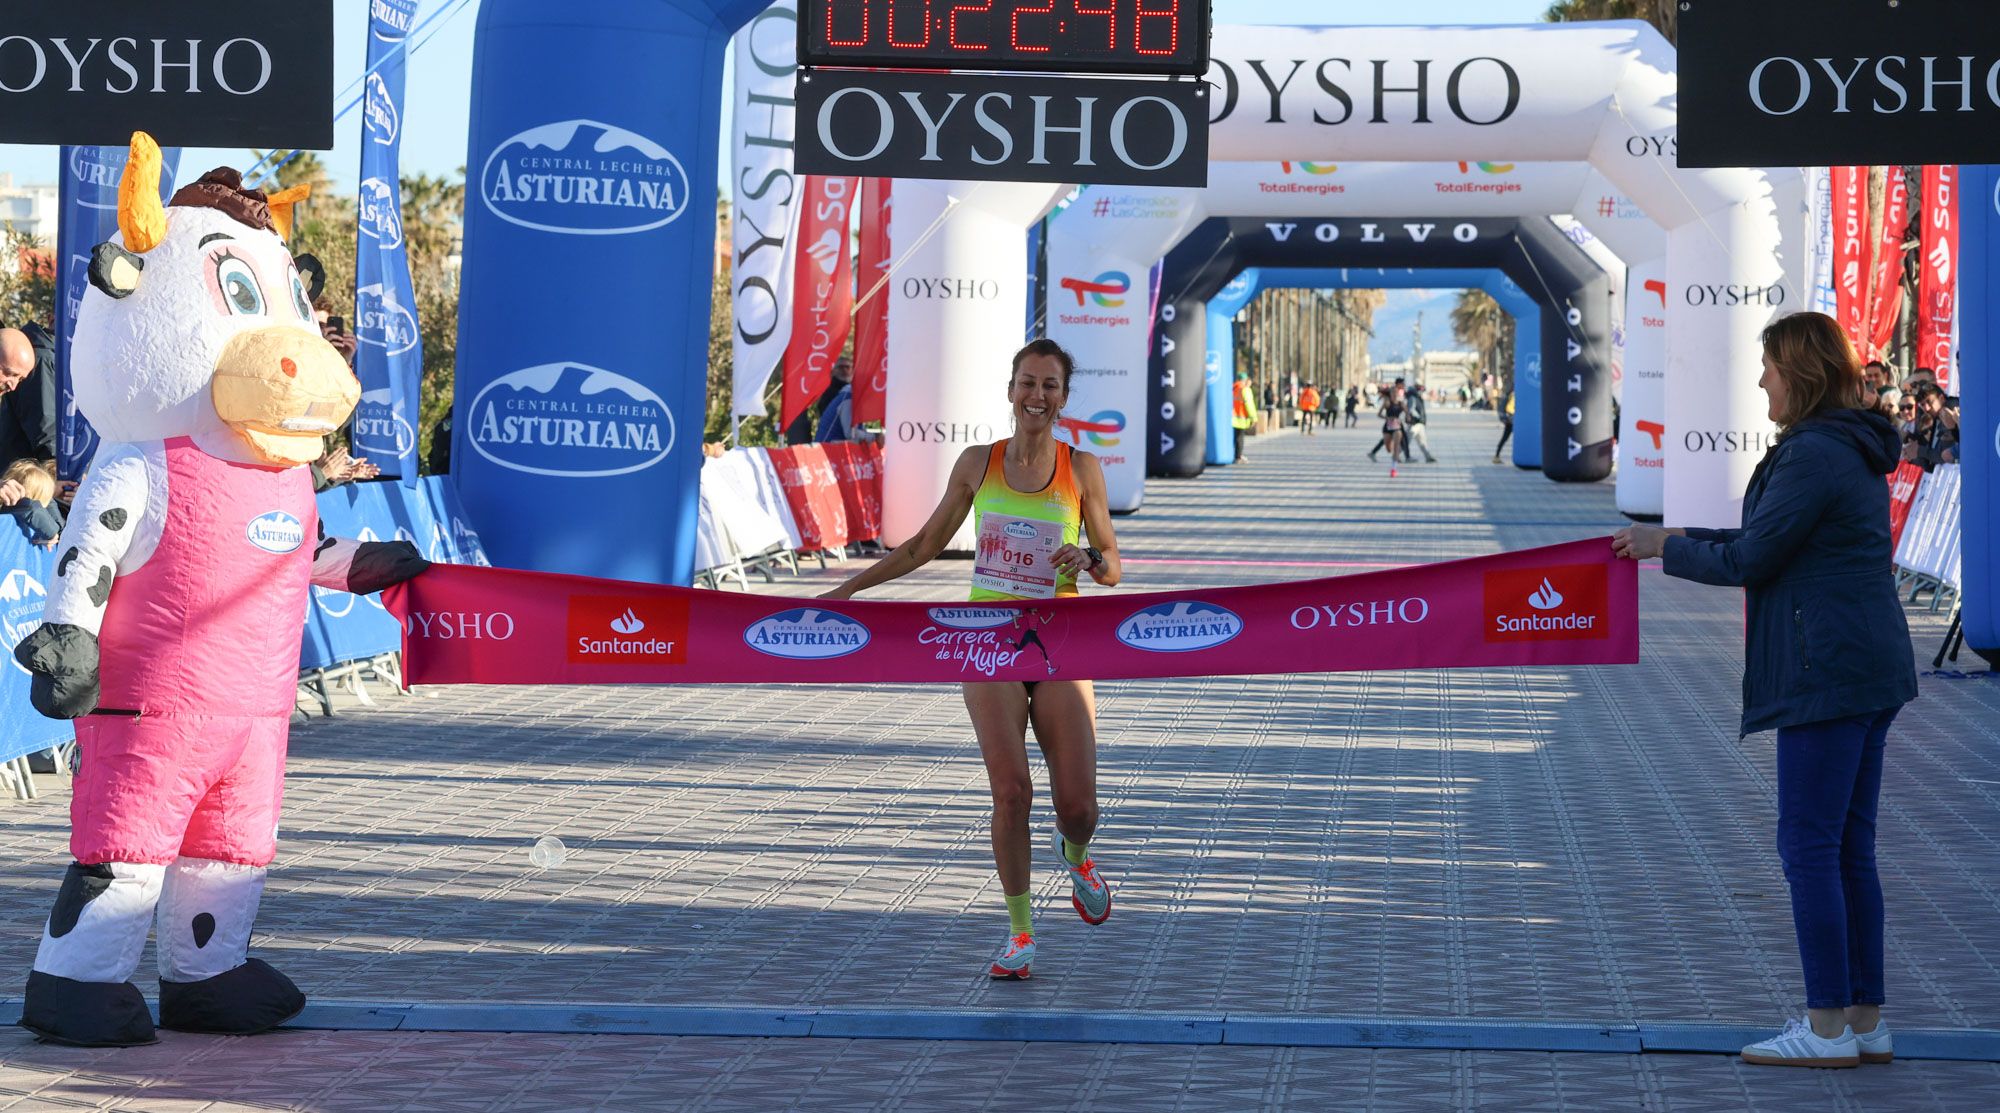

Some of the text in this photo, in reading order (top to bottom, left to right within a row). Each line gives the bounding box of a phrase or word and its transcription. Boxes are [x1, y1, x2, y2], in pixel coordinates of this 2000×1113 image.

[0, 36, 272, 95] OYSHO
[1749, 56, 2000, 115] OYSH
[817, 87, 1188, 170] OYSHO
[520, 157, 672, 177] CENTRAL LECHERA
[491, 159, 677, 212] ASTURIANA
[1259, 182, 1345, 195] TotalEnergies
[1435, 182, 1522, 194] TotalEnergies
[1265, 222, 1479, 242] VOLVO
[904, 278, 998, 300] OYSHO
[1685, 284, 1785, 307] OYSHO
[1060, 315, 1130, 327] TotalEnergies
[1642, 317, 1664, 328] Tota
[1160, 304, 1176, 456] VOLVO
[1567, 307, 1582, 459] VOLVO
[1638, 370, 1664, 379] totale
[506, 400, 658, 418] CENTRAL LECHERA
[477, 400, 662, 451] ASTURIANA
[899, 421, 993, 444] OYSHO
[1634, 457, 1664, 468] TotalE
[1003, 549, 1034, 566] 016
[980, 577, 1005, 588] OYSHO
[936, 606, 1014, 618] ASTURIANA
[1145, 615, 1230, 627] CENTRAL LECHERA
[1290, 597, 1429, 630] OYSHO
[1126, 621, 1233, 640] ASTURIANA
[1496, 612, 1596, 632] Santander
[757, 626, 861, 645] ASTURIANA
[918, 626, 998, 645] Carrera
[579, 637, 674, 655] Santander
[936, 641, 1024, 676] de la Mujer
